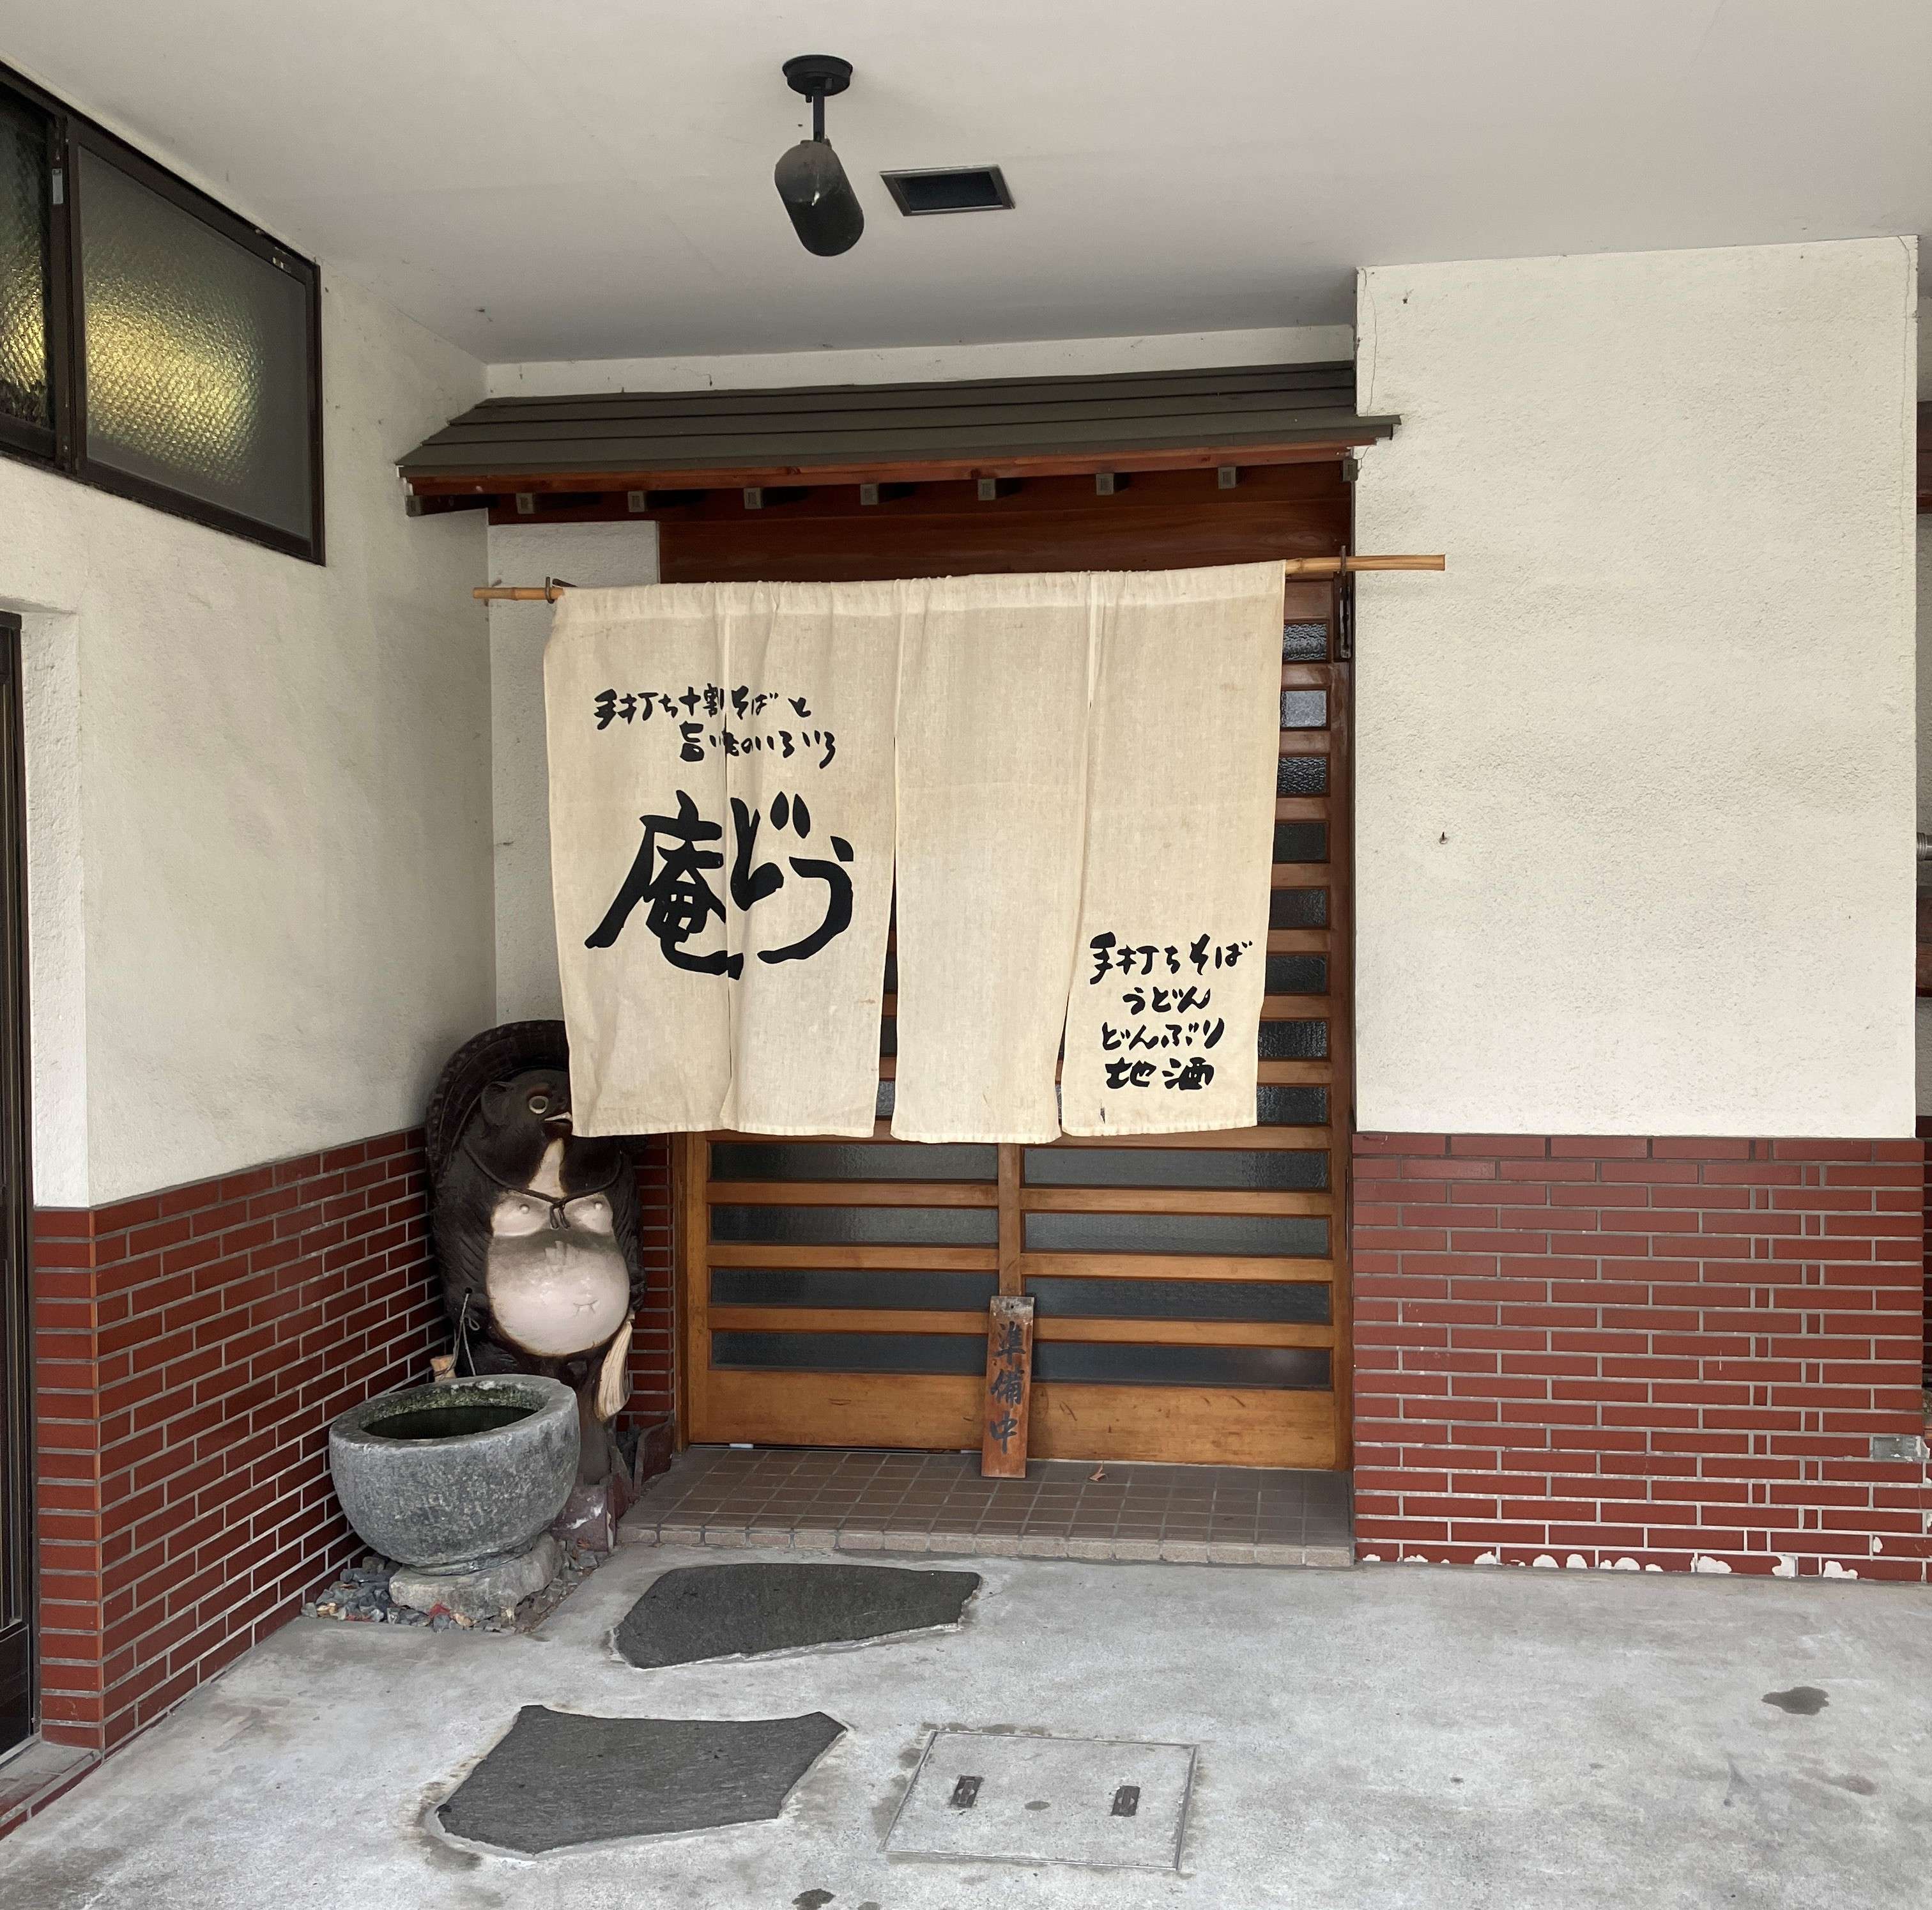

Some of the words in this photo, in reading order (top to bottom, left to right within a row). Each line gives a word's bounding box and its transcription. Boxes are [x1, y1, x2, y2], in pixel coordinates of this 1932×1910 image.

[585, 790, 854, 980] 庵どう
[1090, 932, 1252, 984] 手打ちそば
[1123, 986, 1211, 1015] うどん
[1102, 1018, 1224, 1051] どんぶり
[1105, 1057, 1214, 1090] 地酒
[990, 1321, 1025, 1454] 準備中
